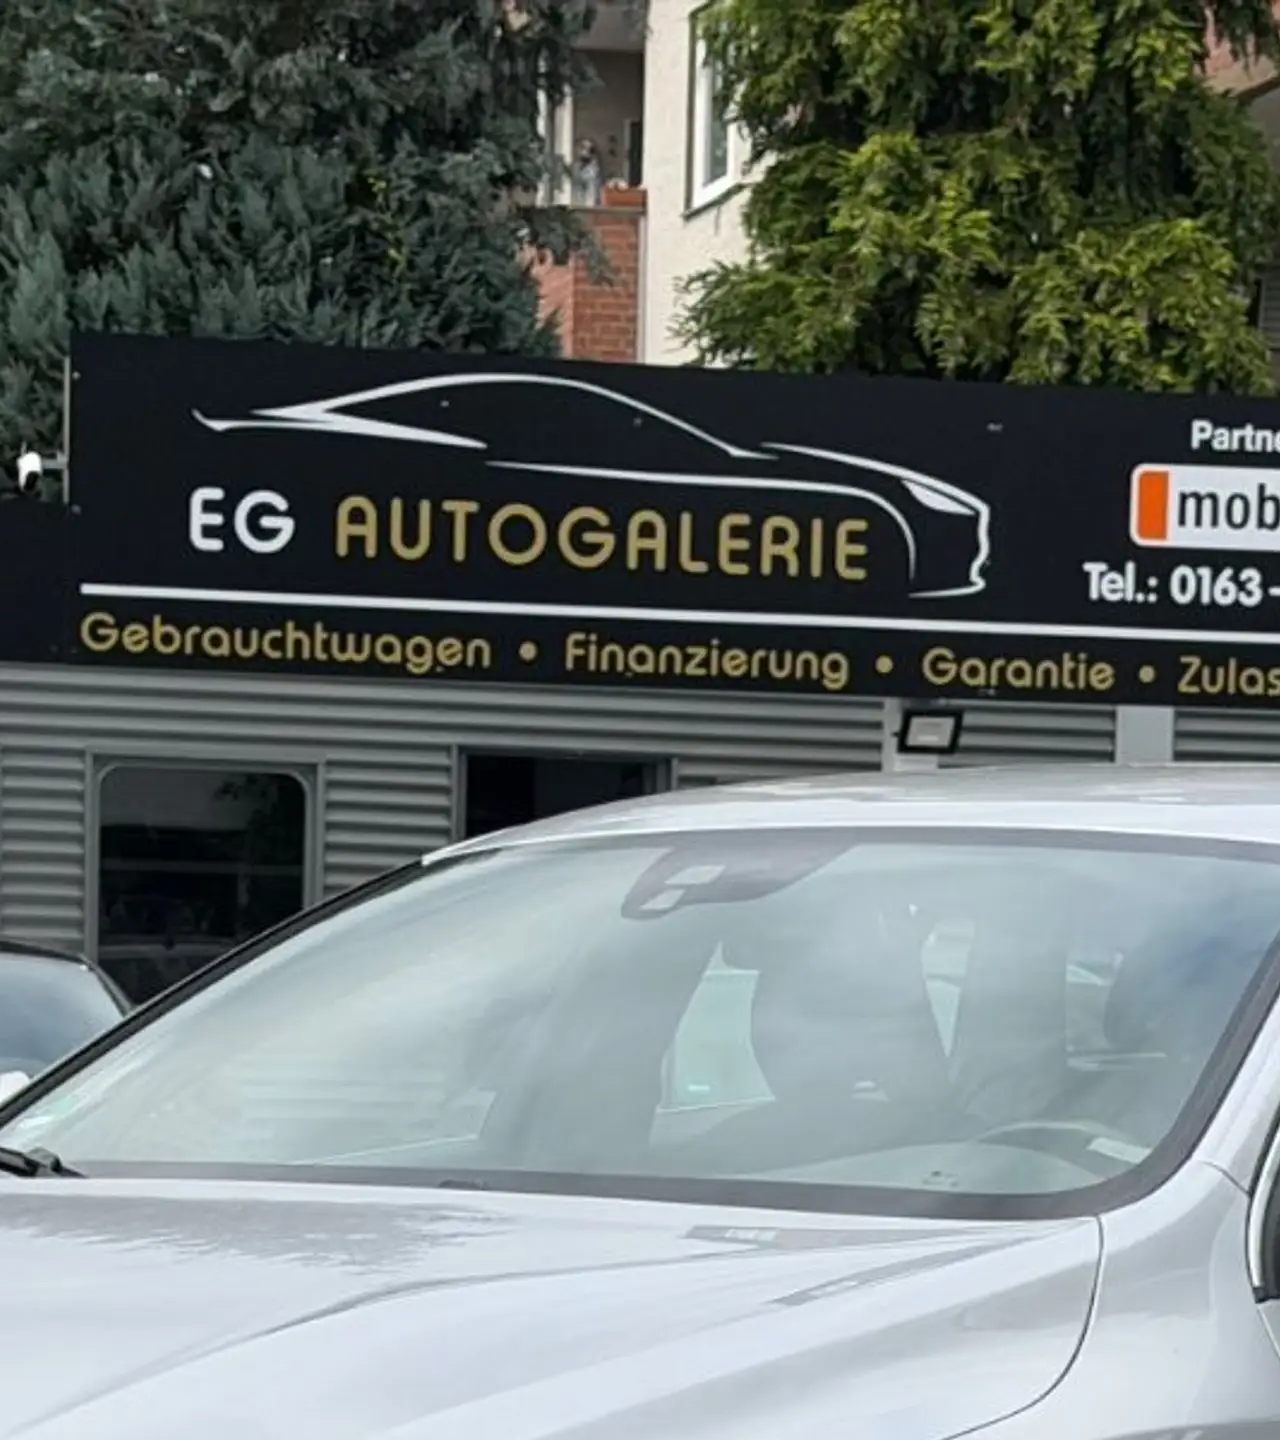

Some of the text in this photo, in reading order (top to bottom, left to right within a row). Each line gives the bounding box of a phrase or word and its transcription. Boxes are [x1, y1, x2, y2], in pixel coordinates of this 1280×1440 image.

[189, 487, 869, 581] EG AUTOGALERIE
[1082, 560, 1159, 604] Tel.:
[80, 612, 492, 674] Gebrauchtwagen
[565, 632, 850, 690] Finanzierung
[922, 647, 1114, 691] Garantie
